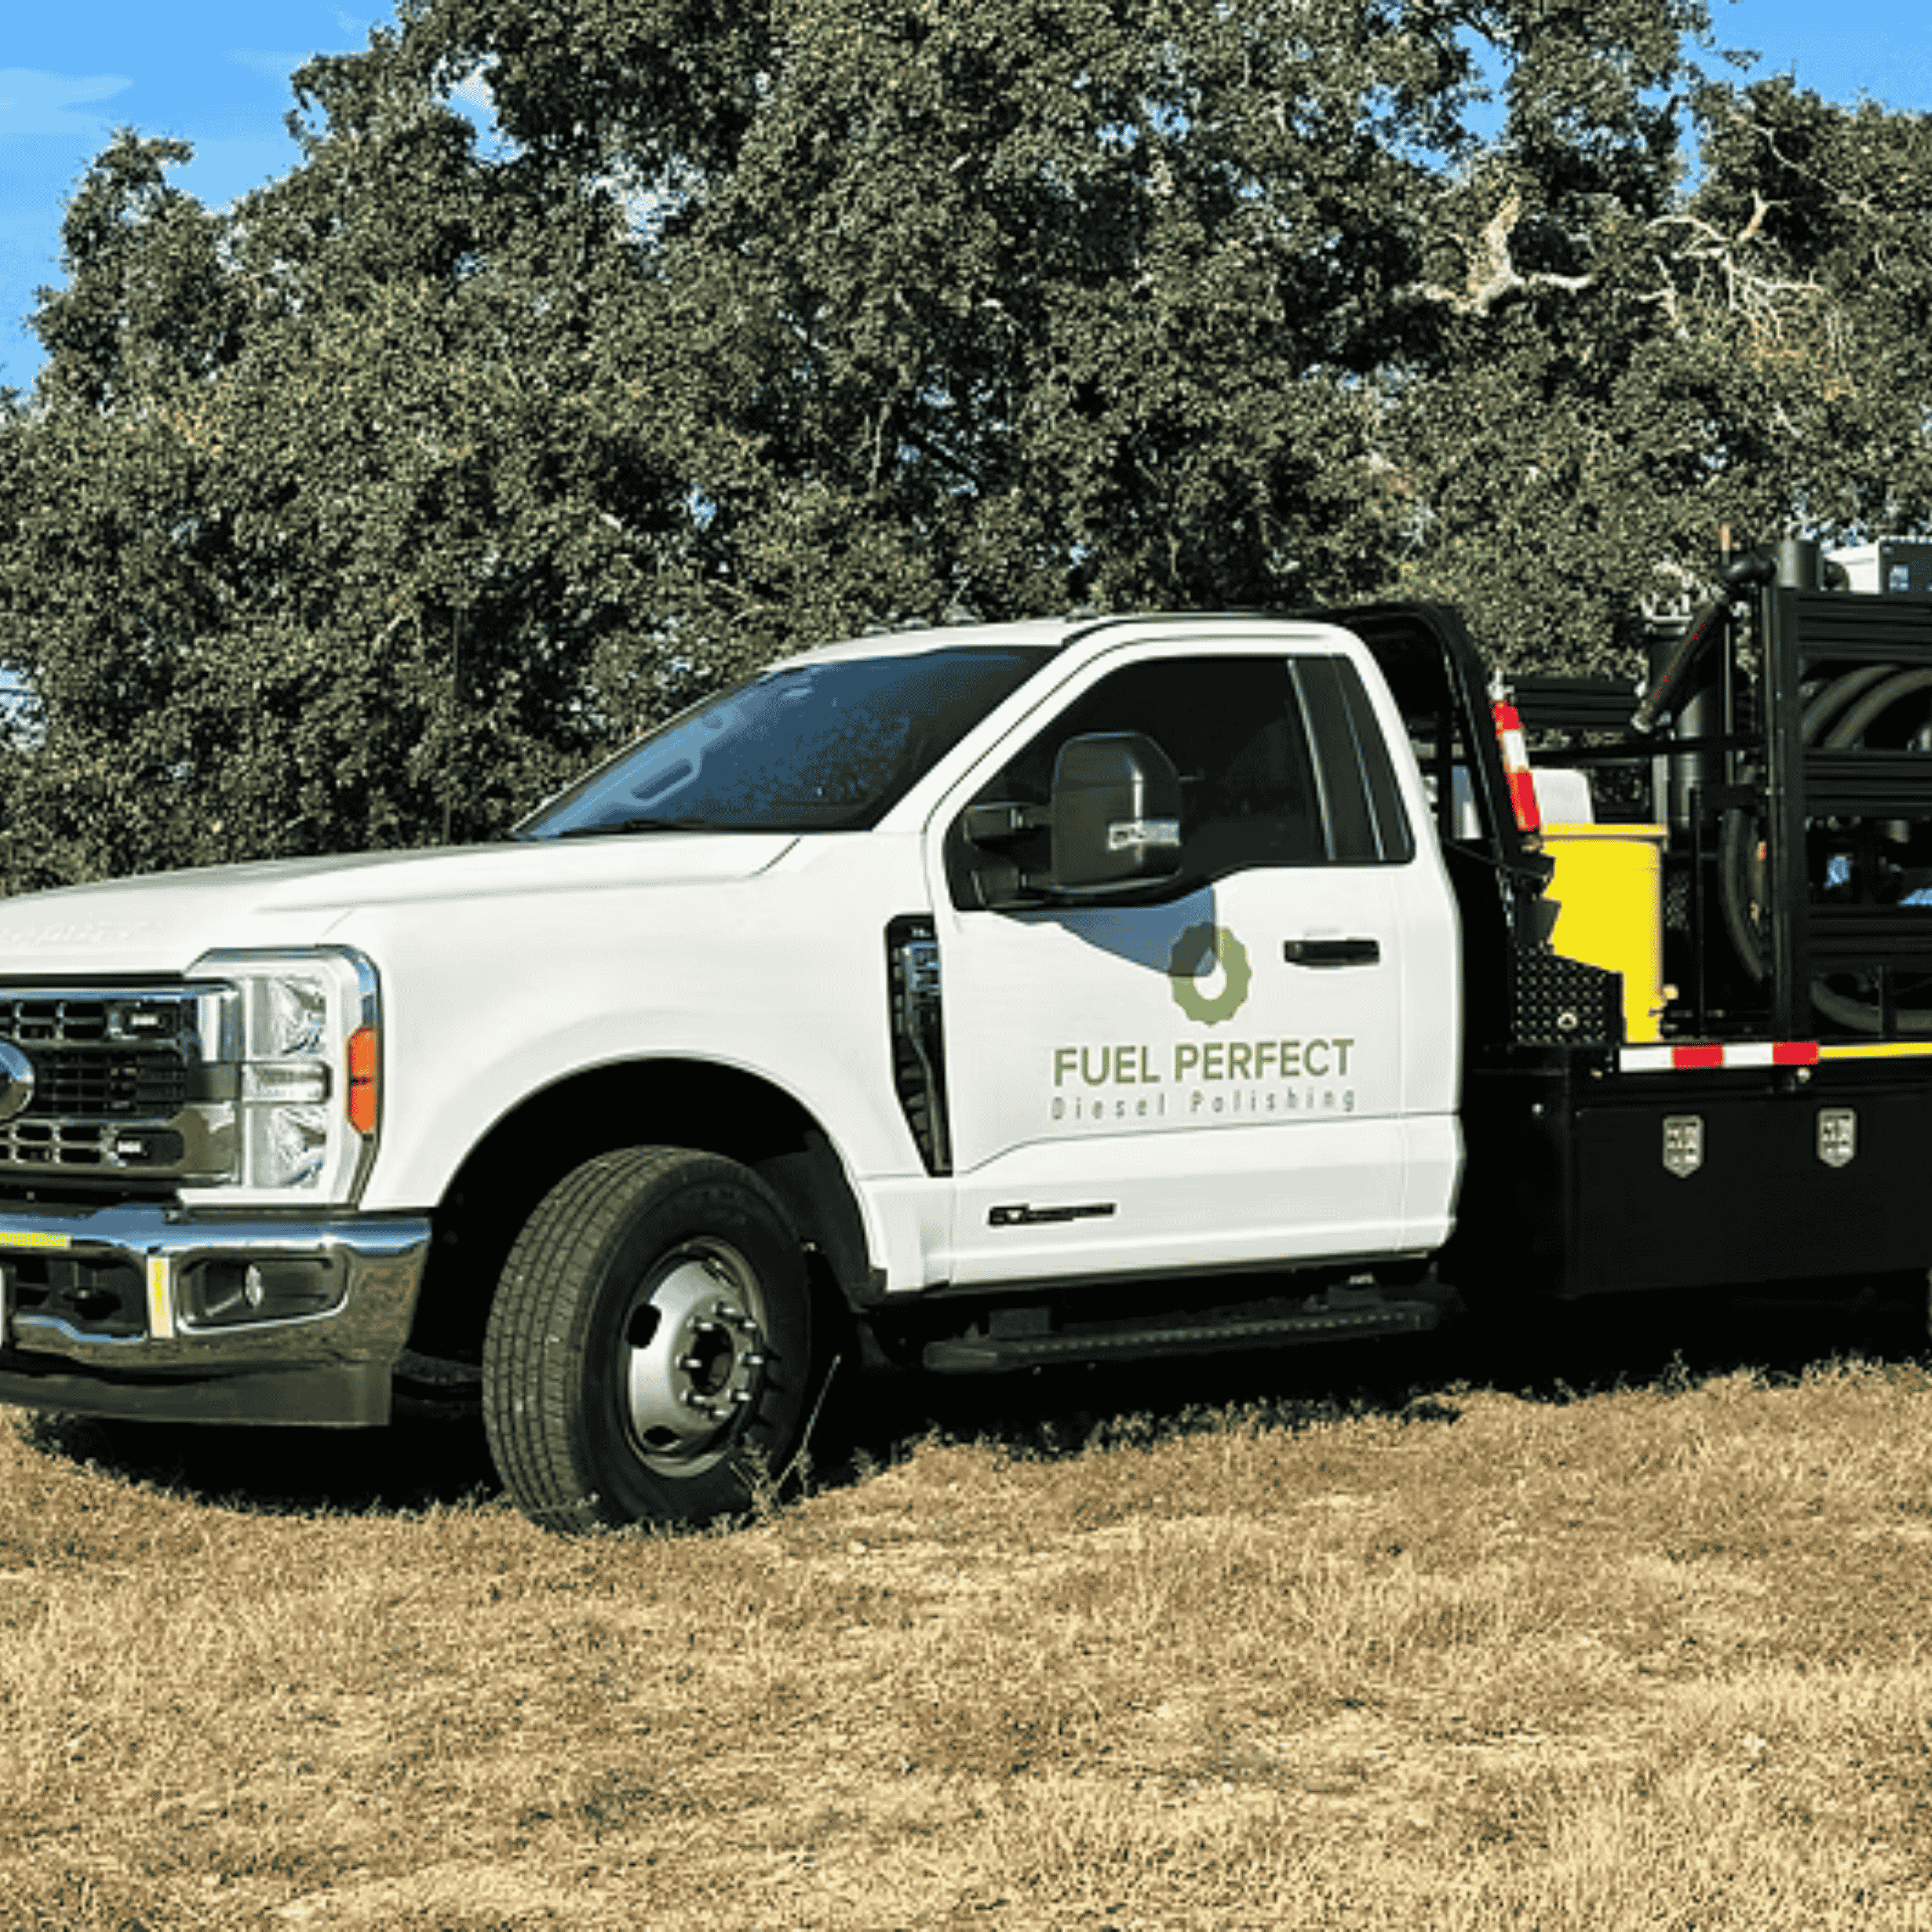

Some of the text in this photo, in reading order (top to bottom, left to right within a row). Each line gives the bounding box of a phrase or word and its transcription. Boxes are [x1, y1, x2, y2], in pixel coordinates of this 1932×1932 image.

[1054, 1038, 1355, 1087] FUEL PERFECT
[1052, 1087, 1355, 1120] Diesel Polishing
